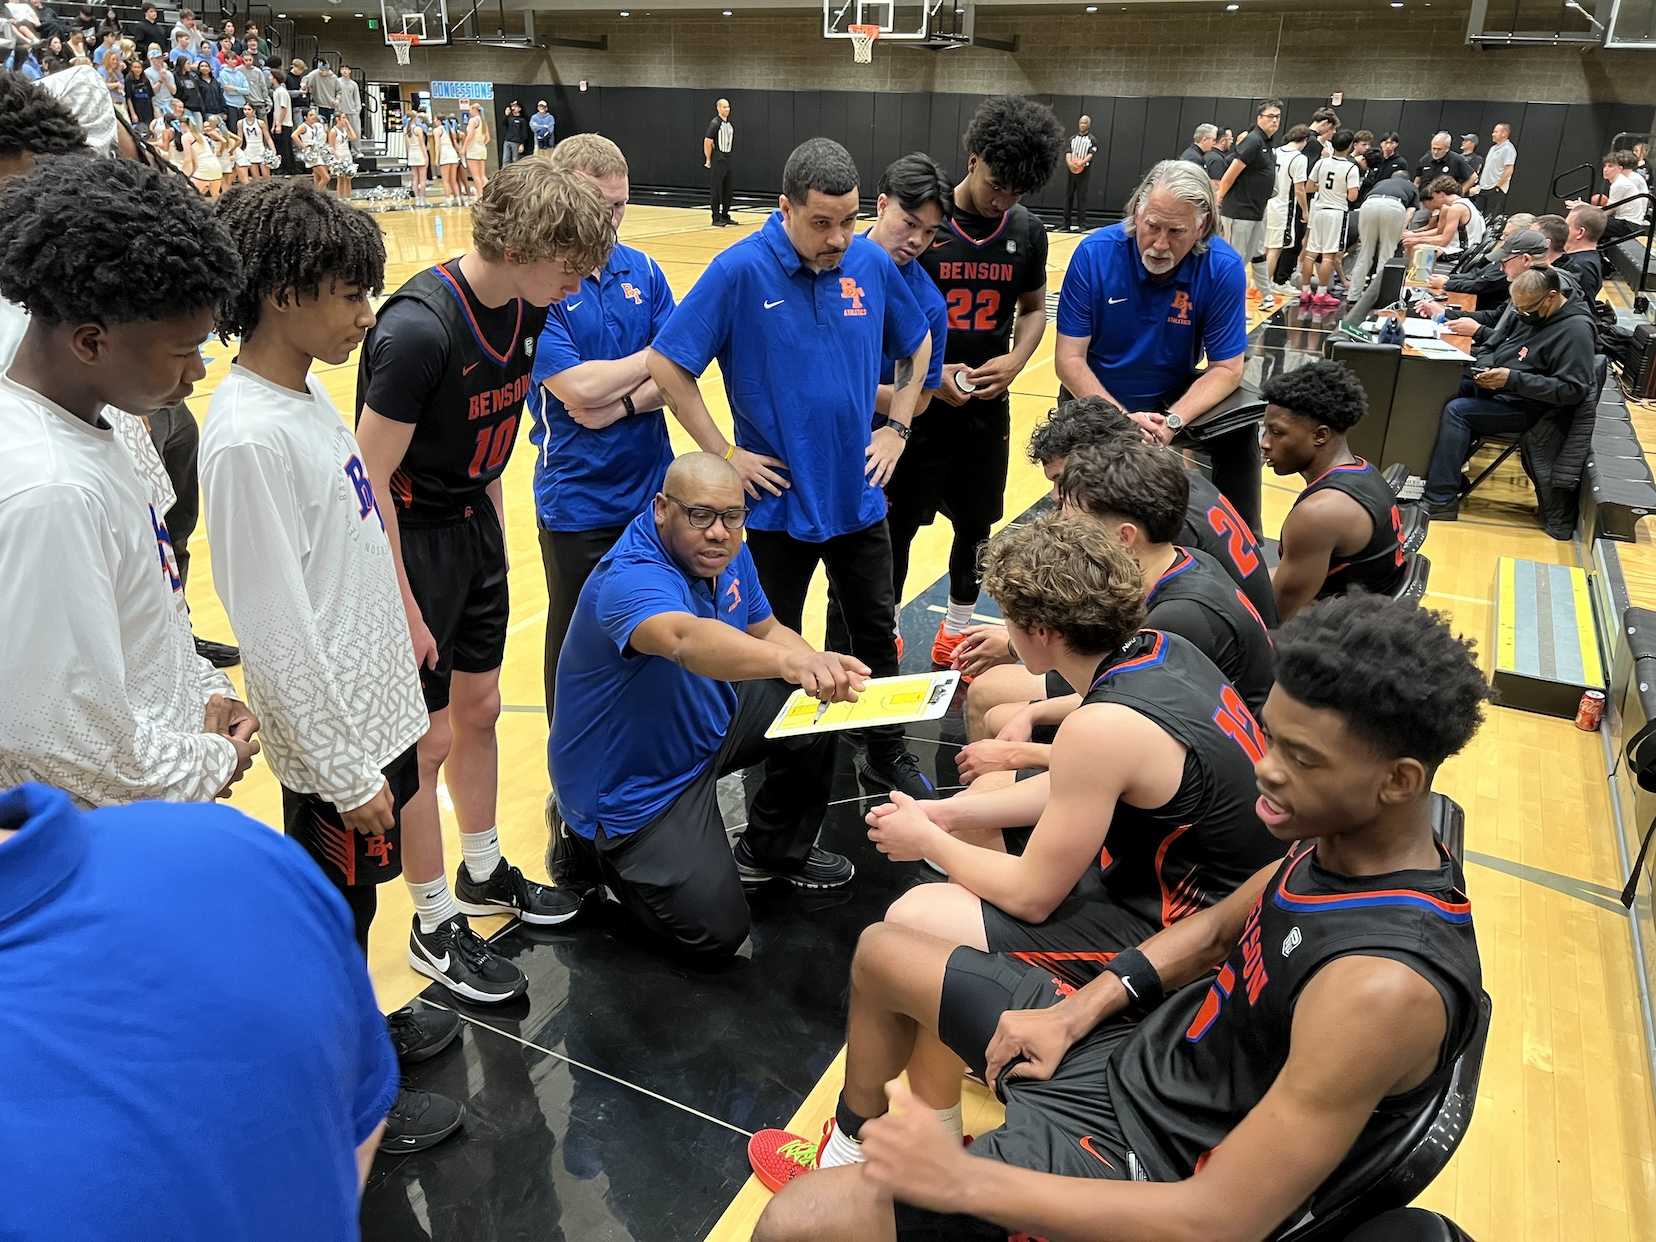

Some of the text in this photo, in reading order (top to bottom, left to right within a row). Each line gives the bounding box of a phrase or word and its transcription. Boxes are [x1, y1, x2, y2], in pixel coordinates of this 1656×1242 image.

[432, 81, 493, 99] CONCESSIONS
[1325, 171, 1335, 190] 5
[939, 261, 1013, 282] BENSON
[946, 288, 1000, 330] 22
[468, 414, 517, 479] 10
